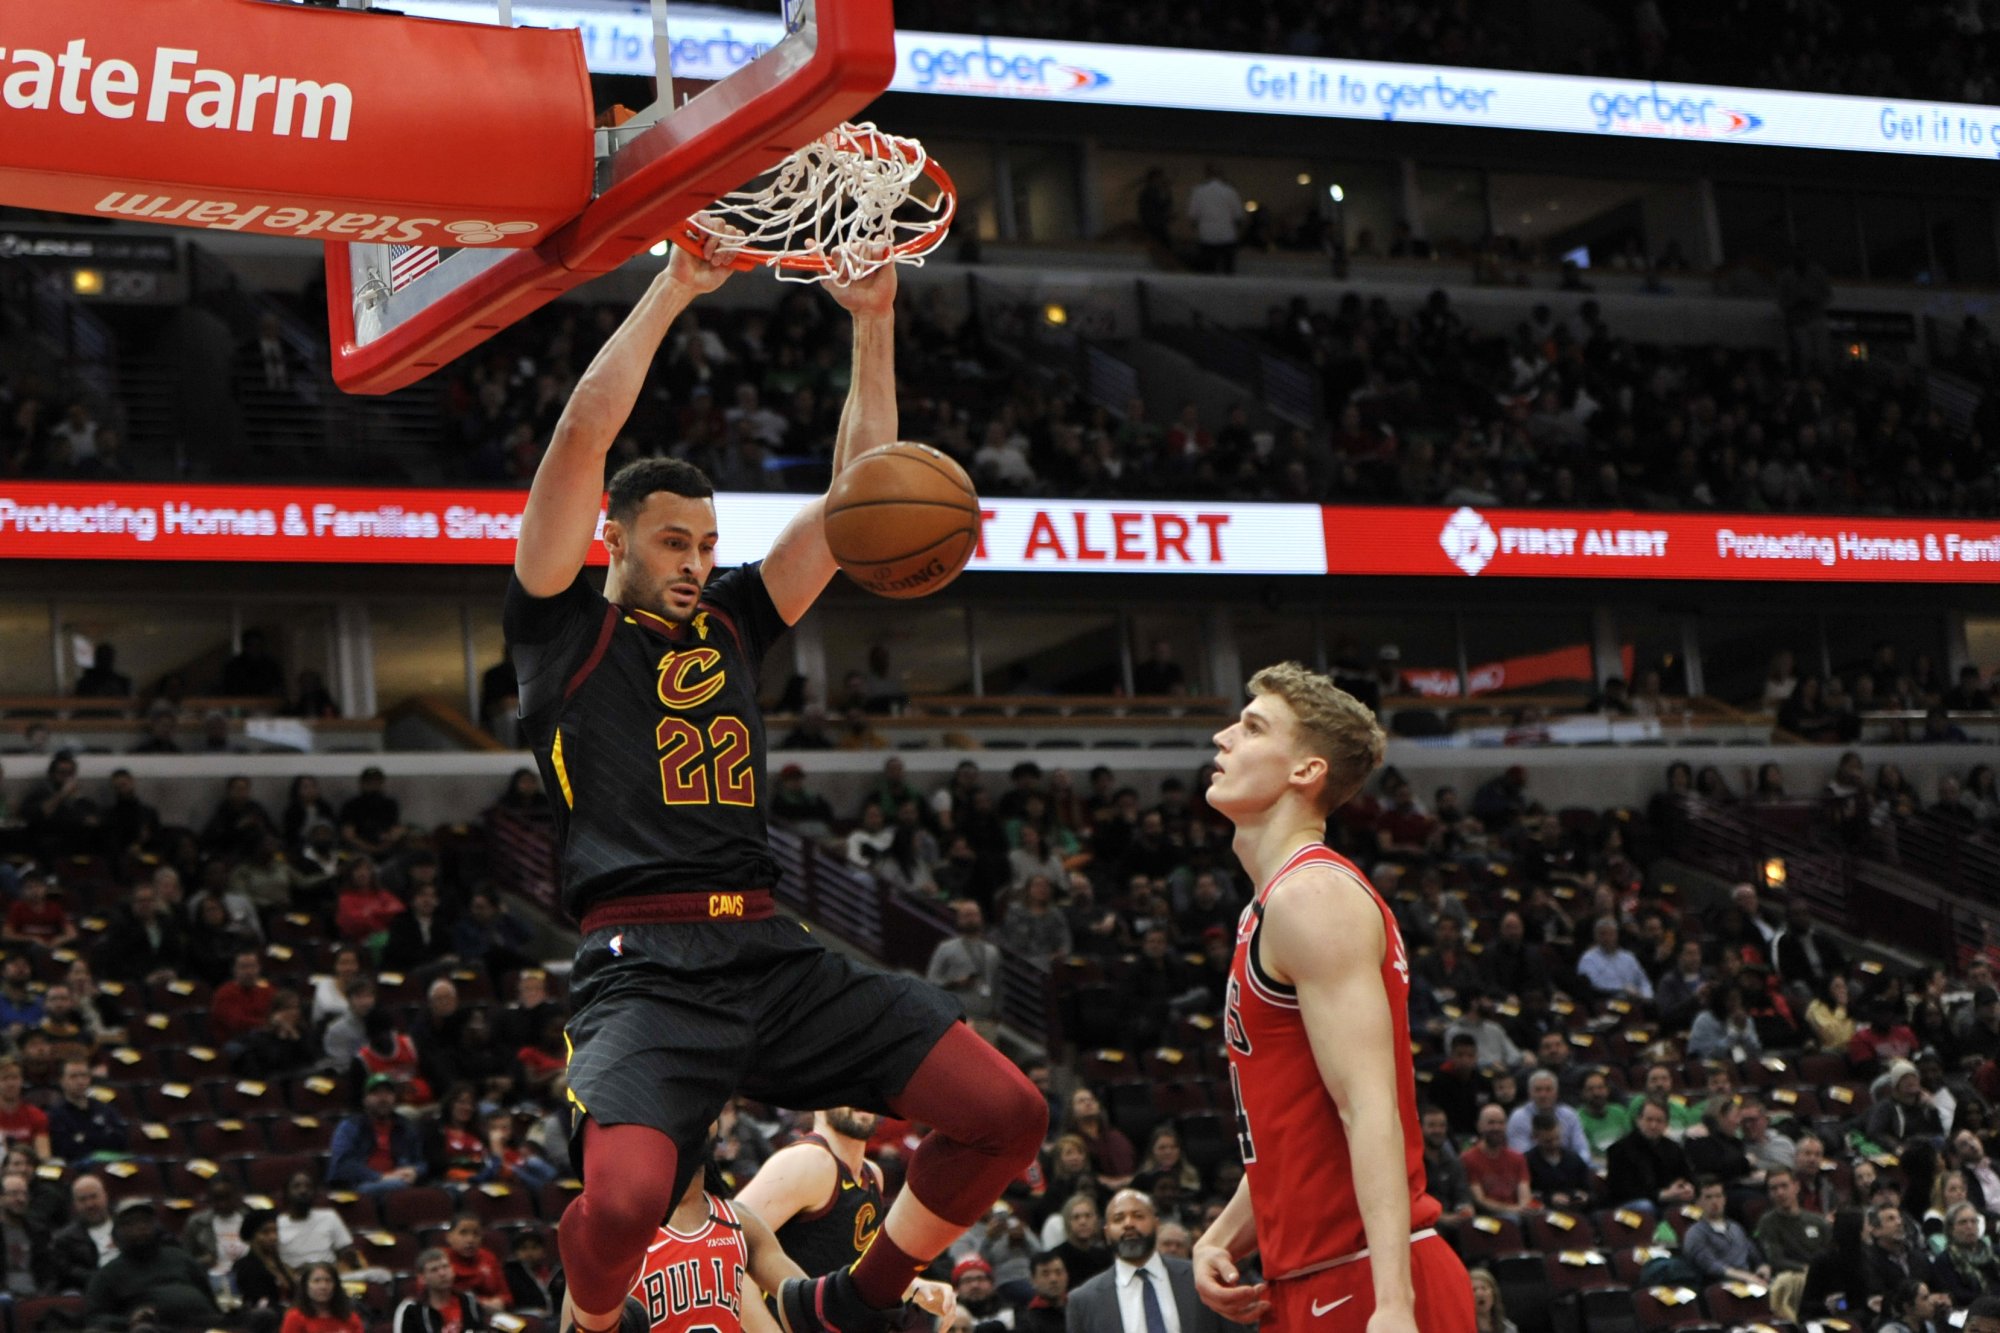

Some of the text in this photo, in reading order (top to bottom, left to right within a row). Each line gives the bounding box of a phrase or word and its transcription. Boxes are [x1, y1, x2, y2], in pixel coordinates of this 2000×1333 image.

[910, 35, 1057, 86] gerber
[1246, 63, 1497, 121] Get it to gerber
[1588, 81, 1715, 131] gerber
[1880, 105, 1923, 141] Get
[1932, 107, 1949, 142] it
[1958, 116, 1983, 146] to
[0, 498, 157, 541] Protecting
[163, 500, 276, 536] Homes
[282, 502, 308, 536] &
[313, 503, 440, 538] Families
[1023, 511, 1230, 562] ALERT
[1499, 527, 1669, 557] FIRST ALERT
[1716, 528, 1836, 566] Protecting
[1838, 531, 1920, 560] Homes
[1924, 533, 1942, 561] &
[655, 716, 755, 808] 22
[708, 894, 744, 917] CAVS
